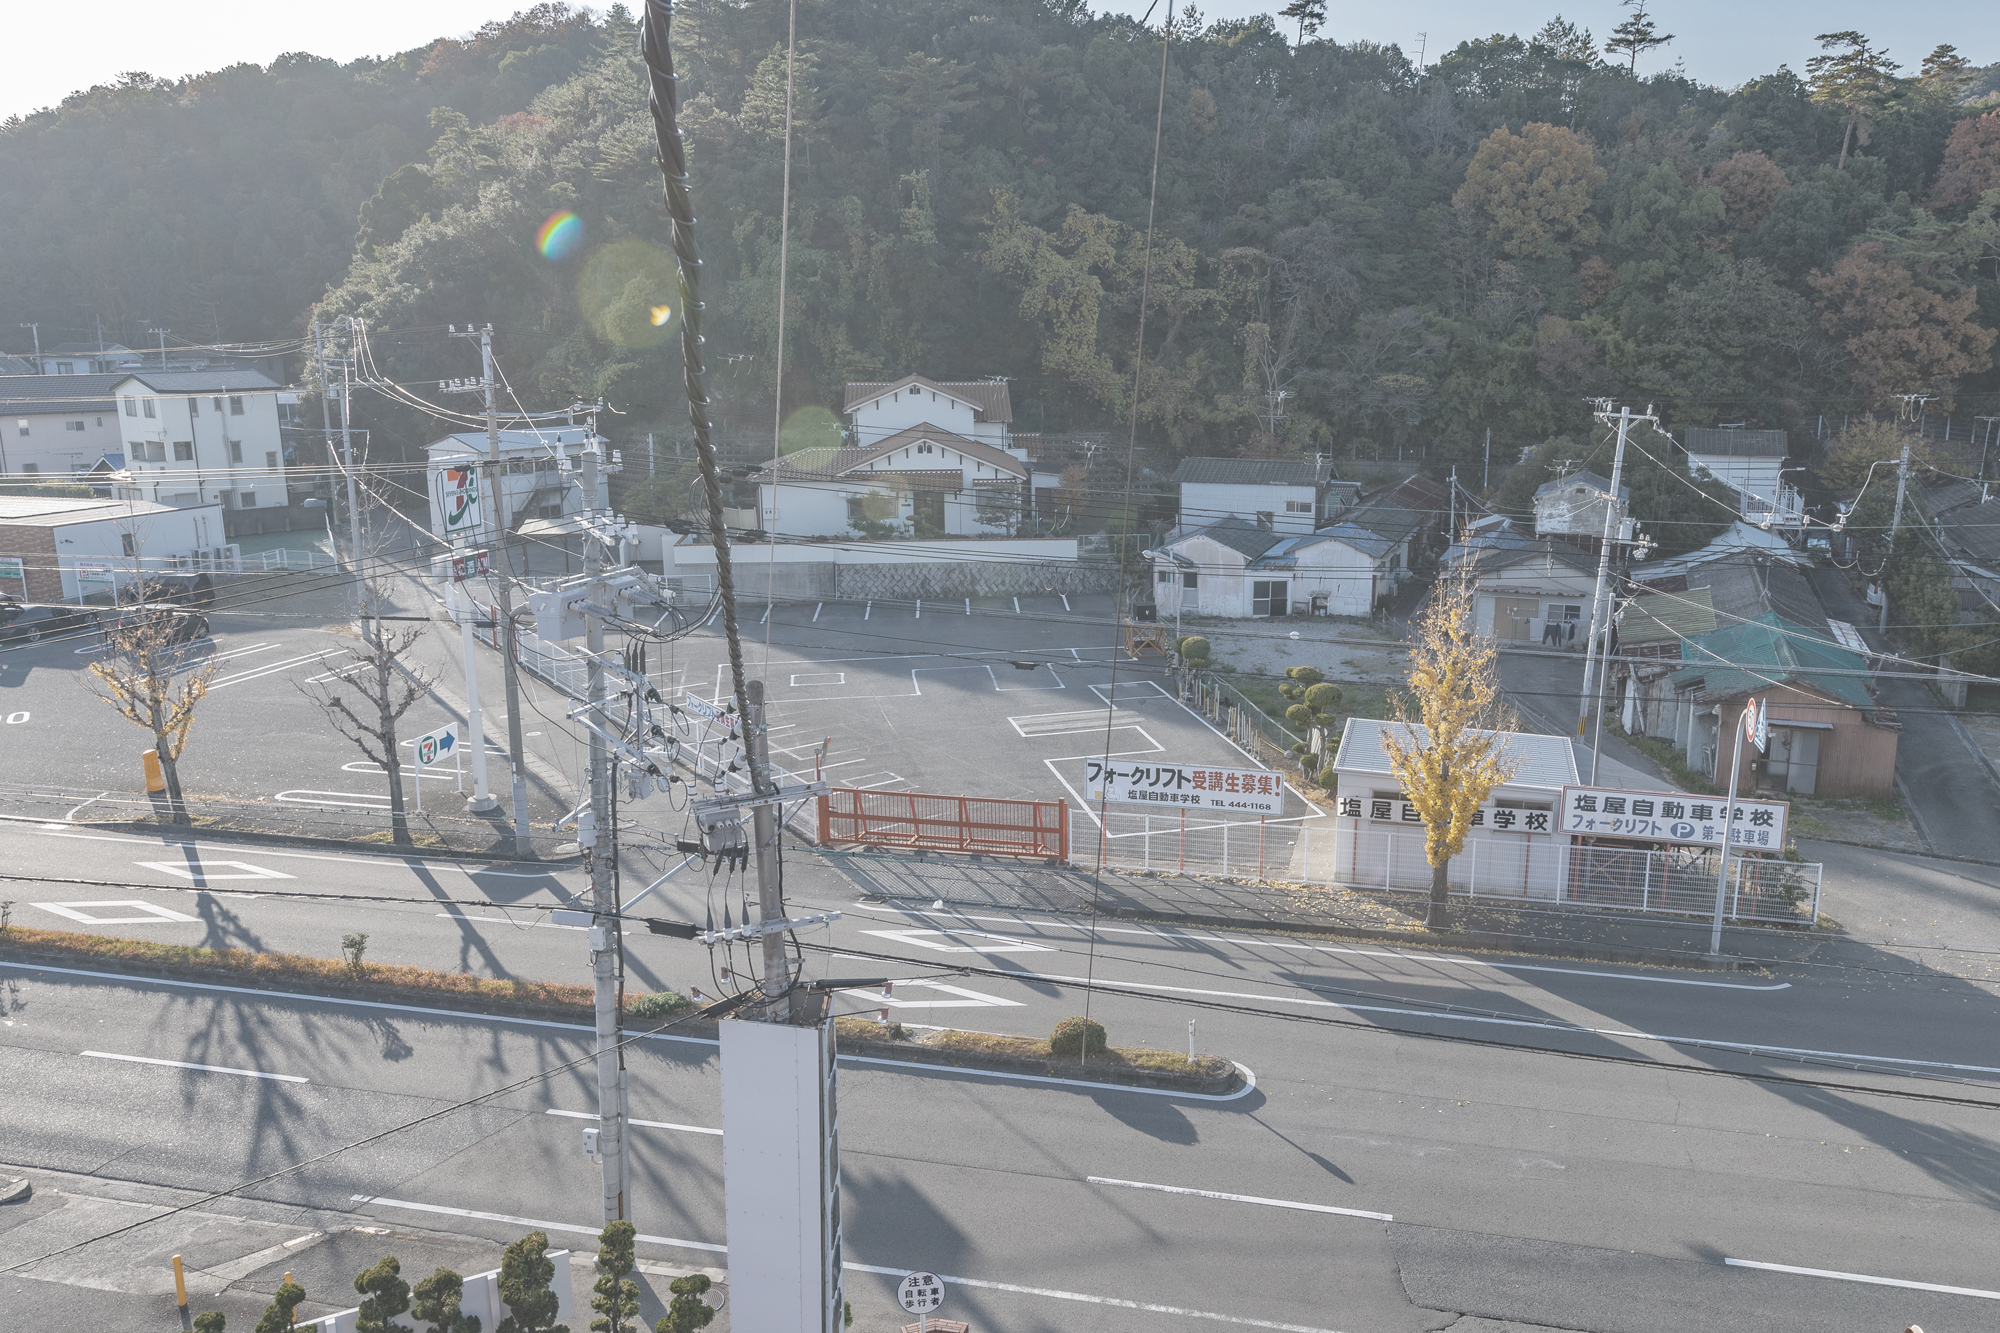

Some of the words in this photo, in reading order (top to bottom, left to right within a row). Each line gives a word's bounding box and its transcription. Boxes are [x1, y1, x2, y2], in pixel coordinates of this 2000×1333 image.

[1128, 789, 1201, 805] 塩屋自動車学校
[1211, 799, 1226, 807] TEL
[1228, 801, 1272, 811] 444-1168
[1574, 794, 1774, 828] 塩屋自動車学校
[1340, 799, 1548, 832] 塩屋自車学校
[1572, 814, 1662, 836] フォークリフト
[1702, 825, 1769, 846] 第一駐車場
[908, 1274, 934, 1288] 注意
[905, 1287, 940, 1299] 自転車
[905, 1297, 940, 1309] 歩行者
